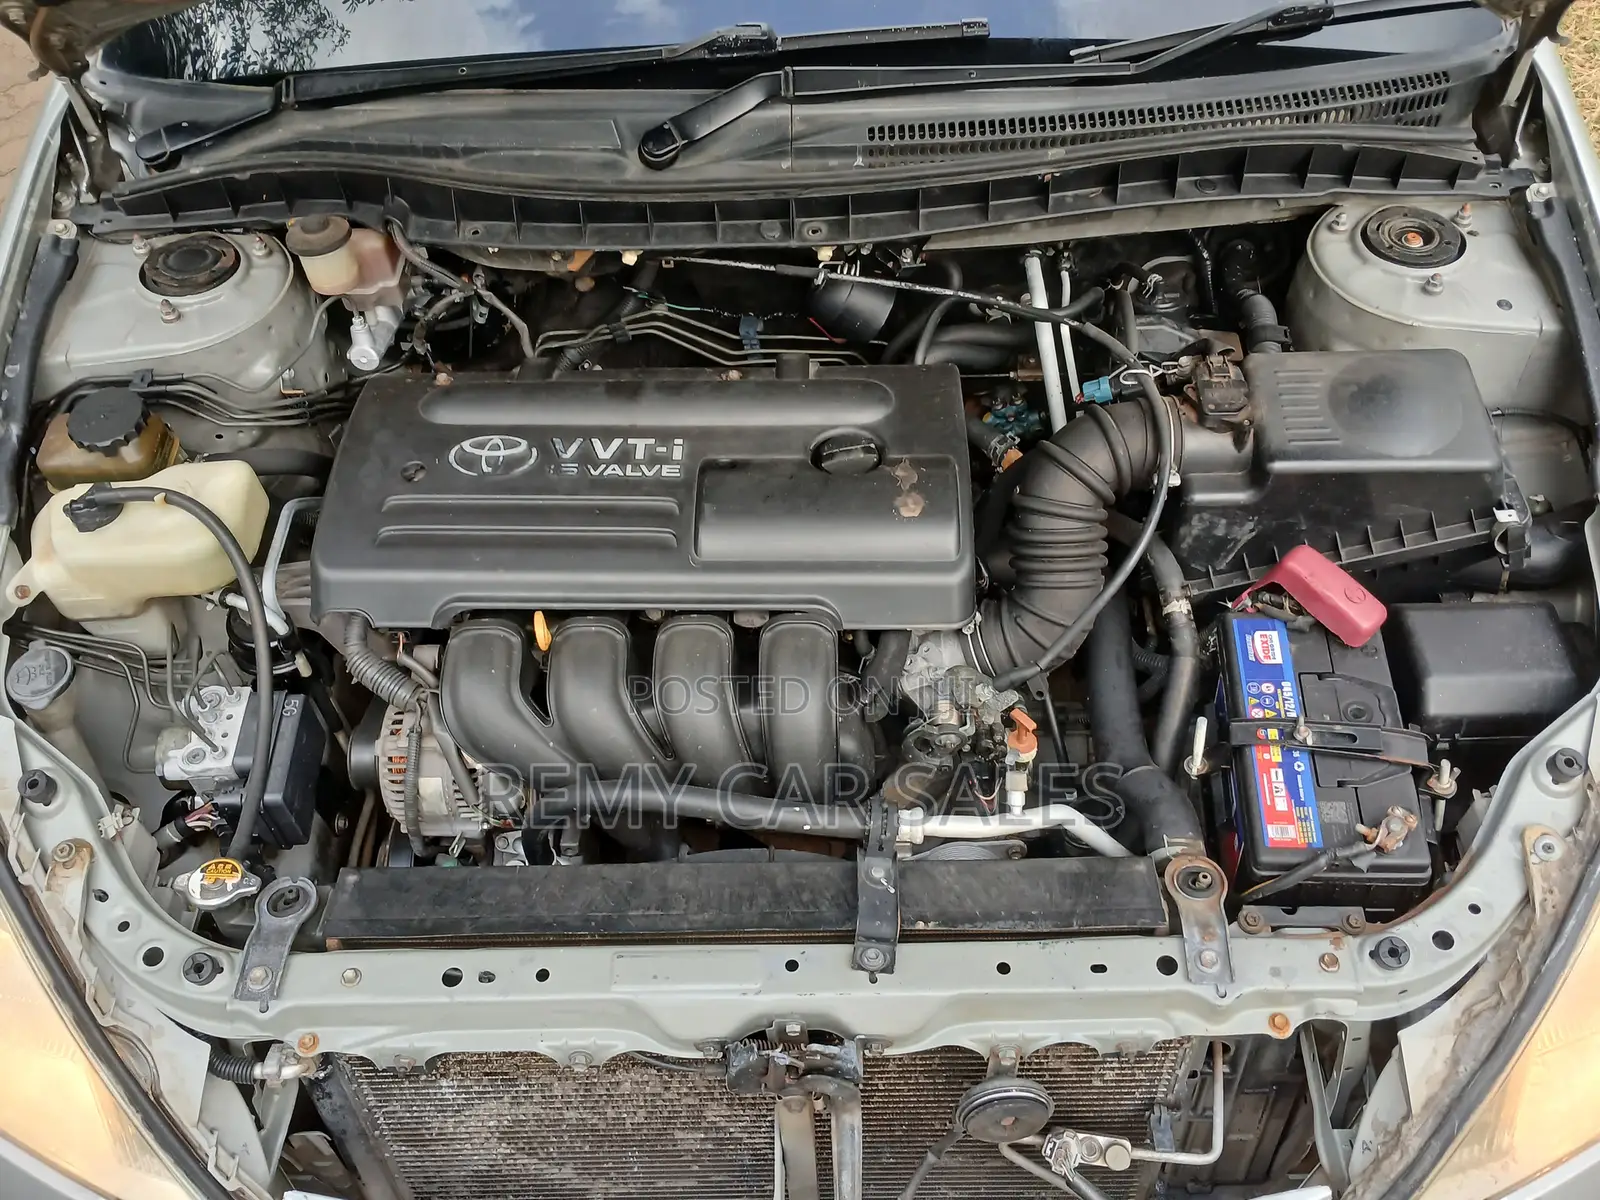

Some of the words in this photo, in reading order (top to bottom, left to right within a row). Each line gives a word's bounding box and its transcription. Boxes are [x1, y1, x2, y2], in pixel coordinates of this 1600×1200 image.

[551, 437, 684, 460] VVT-i
[586, 463, 681, 477] VALVE
[1260, 634, 1271, 660] EXIDE
[283, 699, 299, 716] 5G
